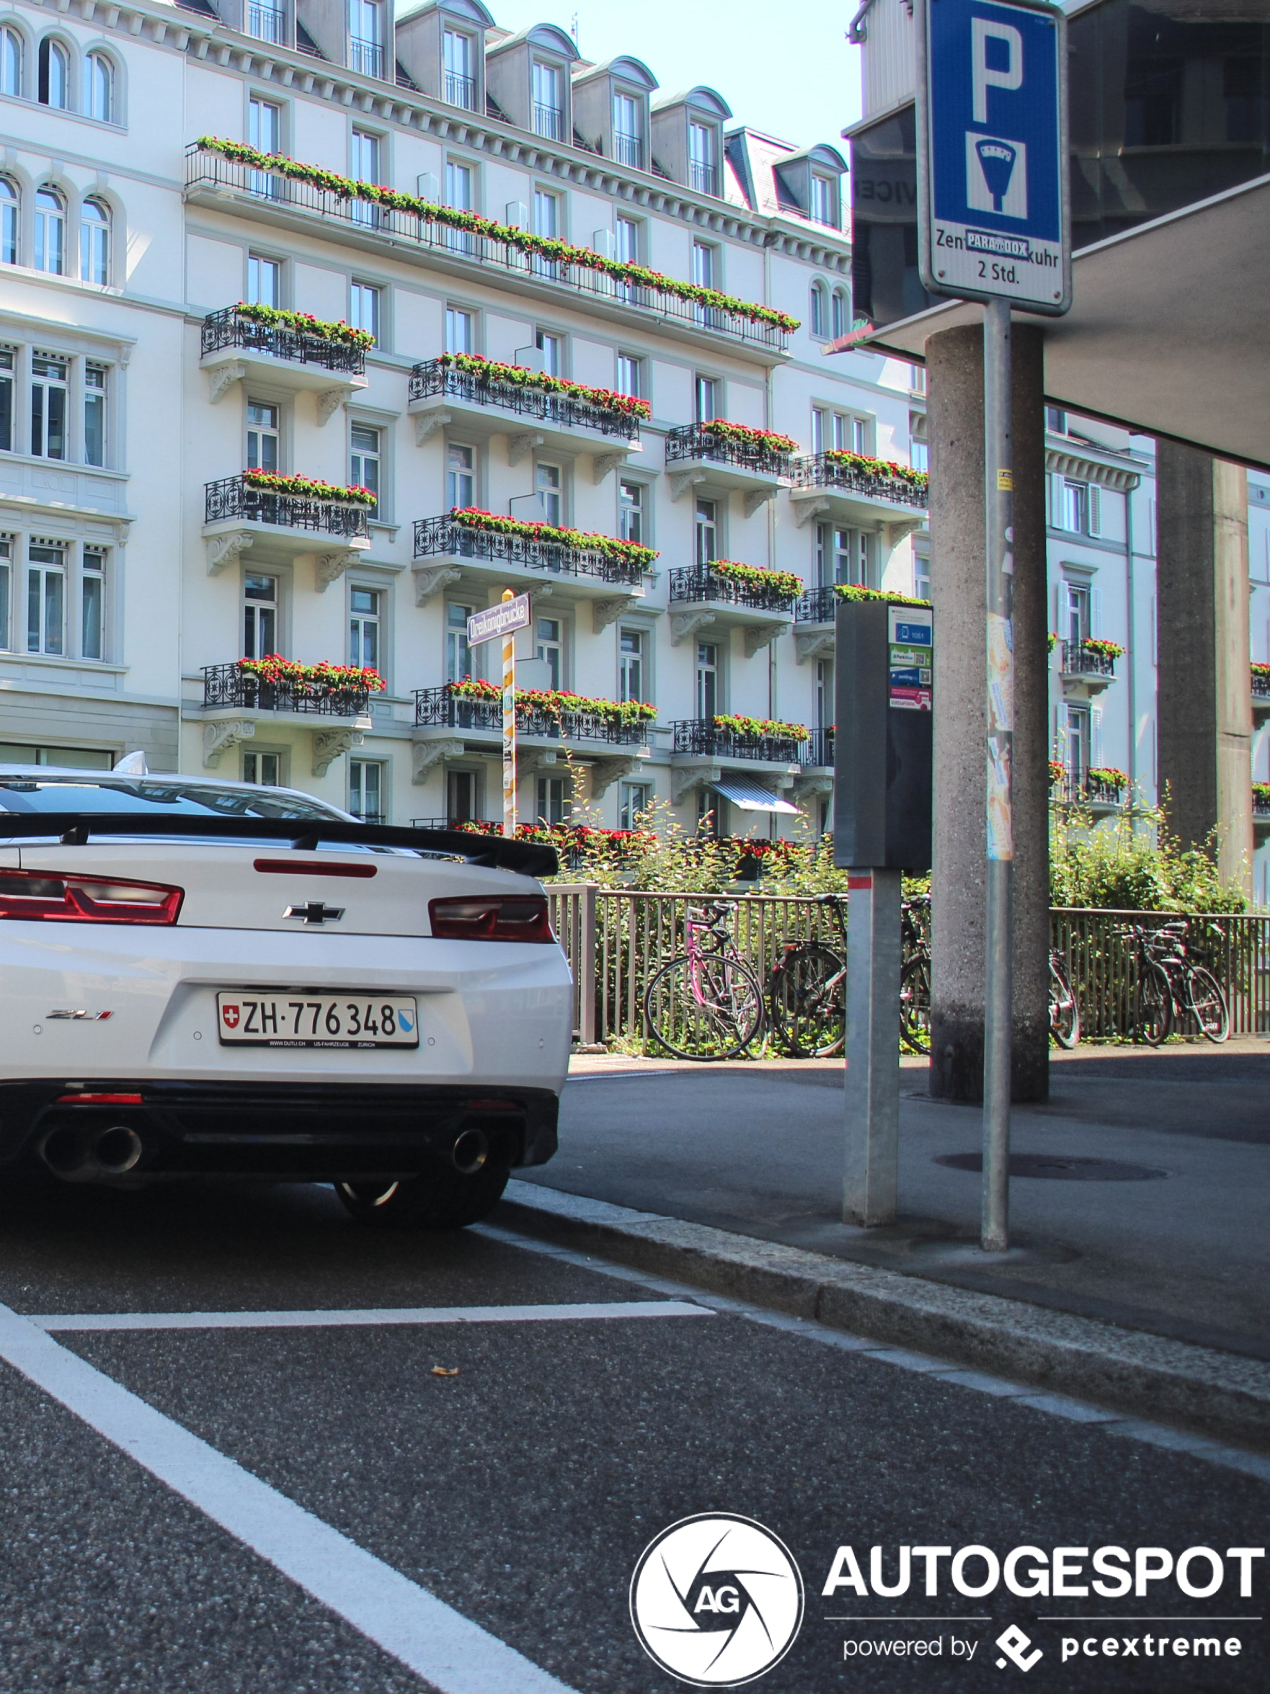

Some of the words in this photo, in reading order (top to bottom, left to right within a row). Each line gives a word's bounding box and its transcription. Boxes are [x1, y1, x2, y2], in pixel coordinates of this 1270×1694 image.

[971, 17, 1023, 124] P
[978, 260, 986, 278] 2
[991, 263, 1020, 284] Std.
